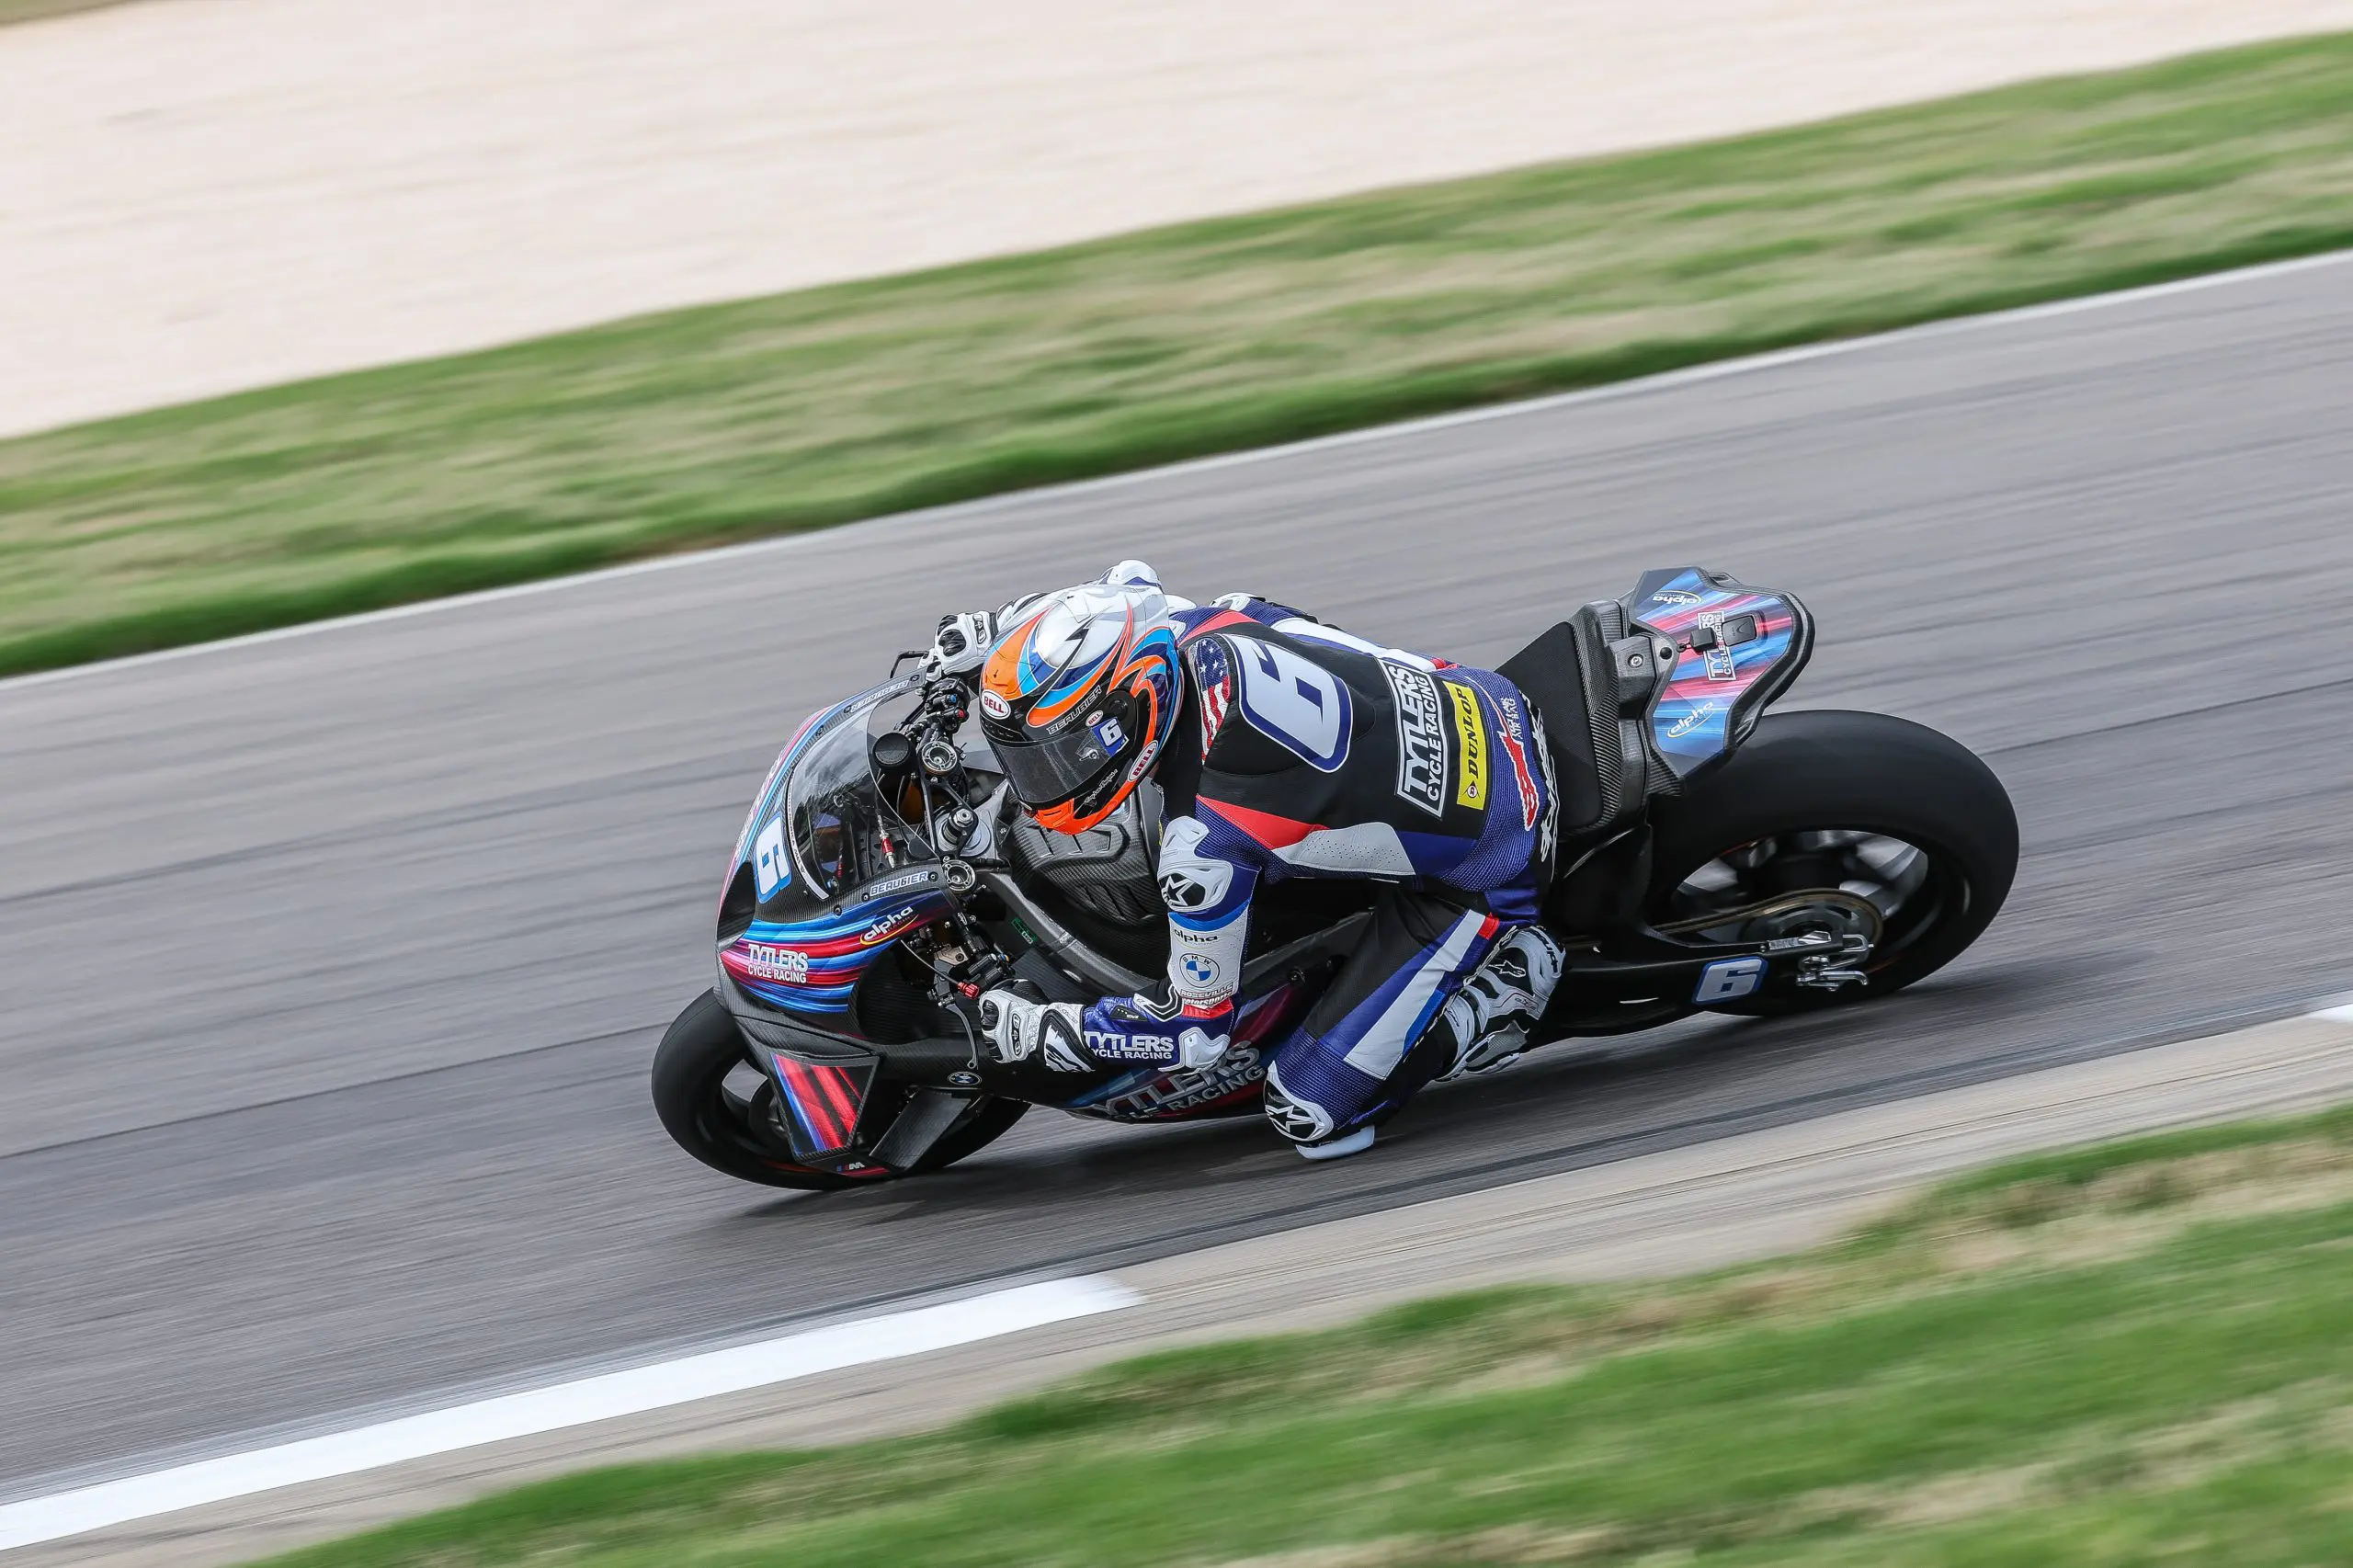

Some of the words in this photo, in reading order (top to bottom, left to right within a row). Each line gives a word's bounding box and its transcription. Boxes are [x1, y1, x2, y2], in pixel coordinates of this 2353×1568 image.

[1653, 596, 1699, 606] alpha
[1701, 613, 1723, 677] TYTRS
[1714, 614, 1724, 644] RACING
[1719, 644, 1732, 676] CYCLE
[983, 695, 1006, 714] BELL
[1223, 633, 1342, 760] 6
[1415, 675, 1438, 736] RACING
[1099, 718, 1122, 746] 6
[1388, 665, 1428, 793] TYTLERS
[1456, 687, 1479, 779] DUNLOP
[1670, 701, 1714, 734] alpha
[1132, 747, 1155, 777] BELL
[1427, 737, 1442, 801] CYCLE
[756, 814, 790, 897] 6
[863, 906, 914, 941] alpha
[1174, 928, 1218, 943] alpha
[747, 963, 772, 979] CYCLE
[773, 968, 807, 983] RACING
[748, 943, 809, 972] TYTLERS
[1695, 958, 1762, 1002] 6
[1083, 1030, 1174, 1052] TYTLERS
[1090, 1048, 1122, 1059] YCLE
[1124, 1051, 1173, 1060] RACING
[1165, 1064, 1267, 1112] RACING
